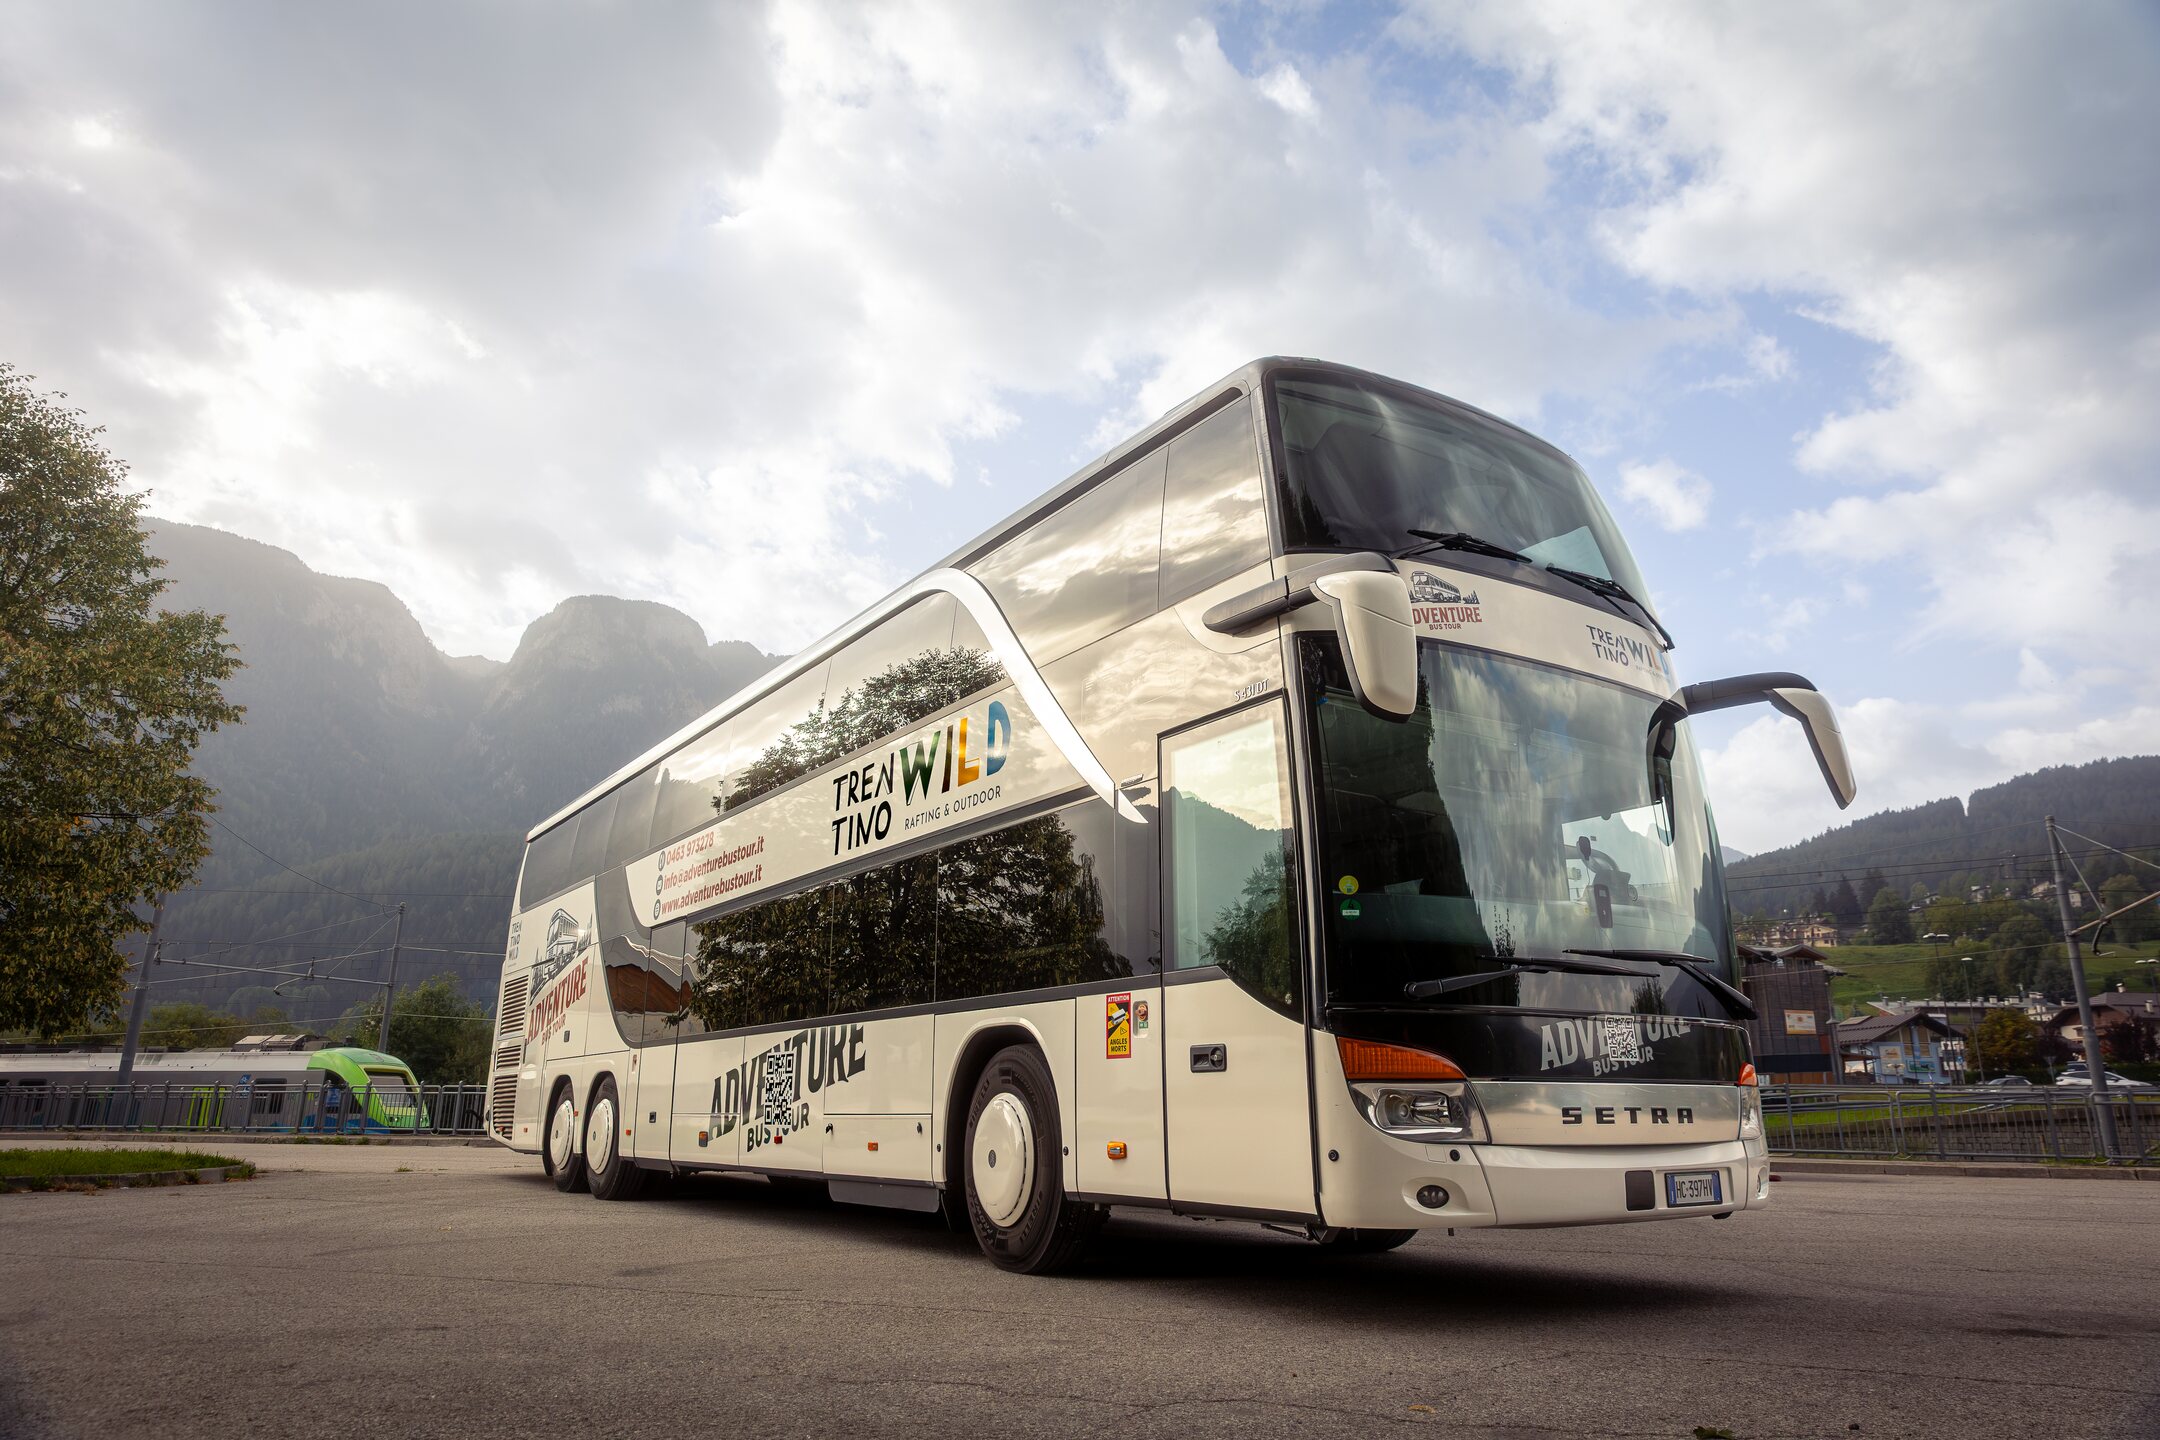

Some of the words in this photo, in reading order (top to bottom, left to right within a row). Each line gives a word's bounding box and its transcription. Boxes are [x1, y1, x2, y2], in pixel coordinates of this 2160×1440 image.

[1412, 607, 1482, 624] DVENTURE
[1586, 625, 1625, 651] TREN
[1592, 642, 1629, 666] TINO
[1624, 637, 1669, 675] WILD
[899, 700, 1011, 806] WILD
[832, 752, 894, 811] TREN
[832, 800, 892, 855] TINO
[904, 807, 941, 830] RAFTING
[944, 803, 950, 817] &
[953, 785, 1001, 813] OUTDOOR
[663, 836, 764, 890] info@adventurebustour.it
[666, 843, 686, 865] 0463
[686, 831, 714, 857] 973278
[661, 864, 762, 915] www.adventurebustour.it
[527, 956, 588, 1045] ADVENTURE
[707, 1024, 866, 1141] ADVETURE
[1593, 1056, 1619, 1077] BUS
[1624, 1047, 1654, 1068] UR
[1562, 1107, 1694, 1124] SETRA
[747, 1122, 770, 1152] BUS
